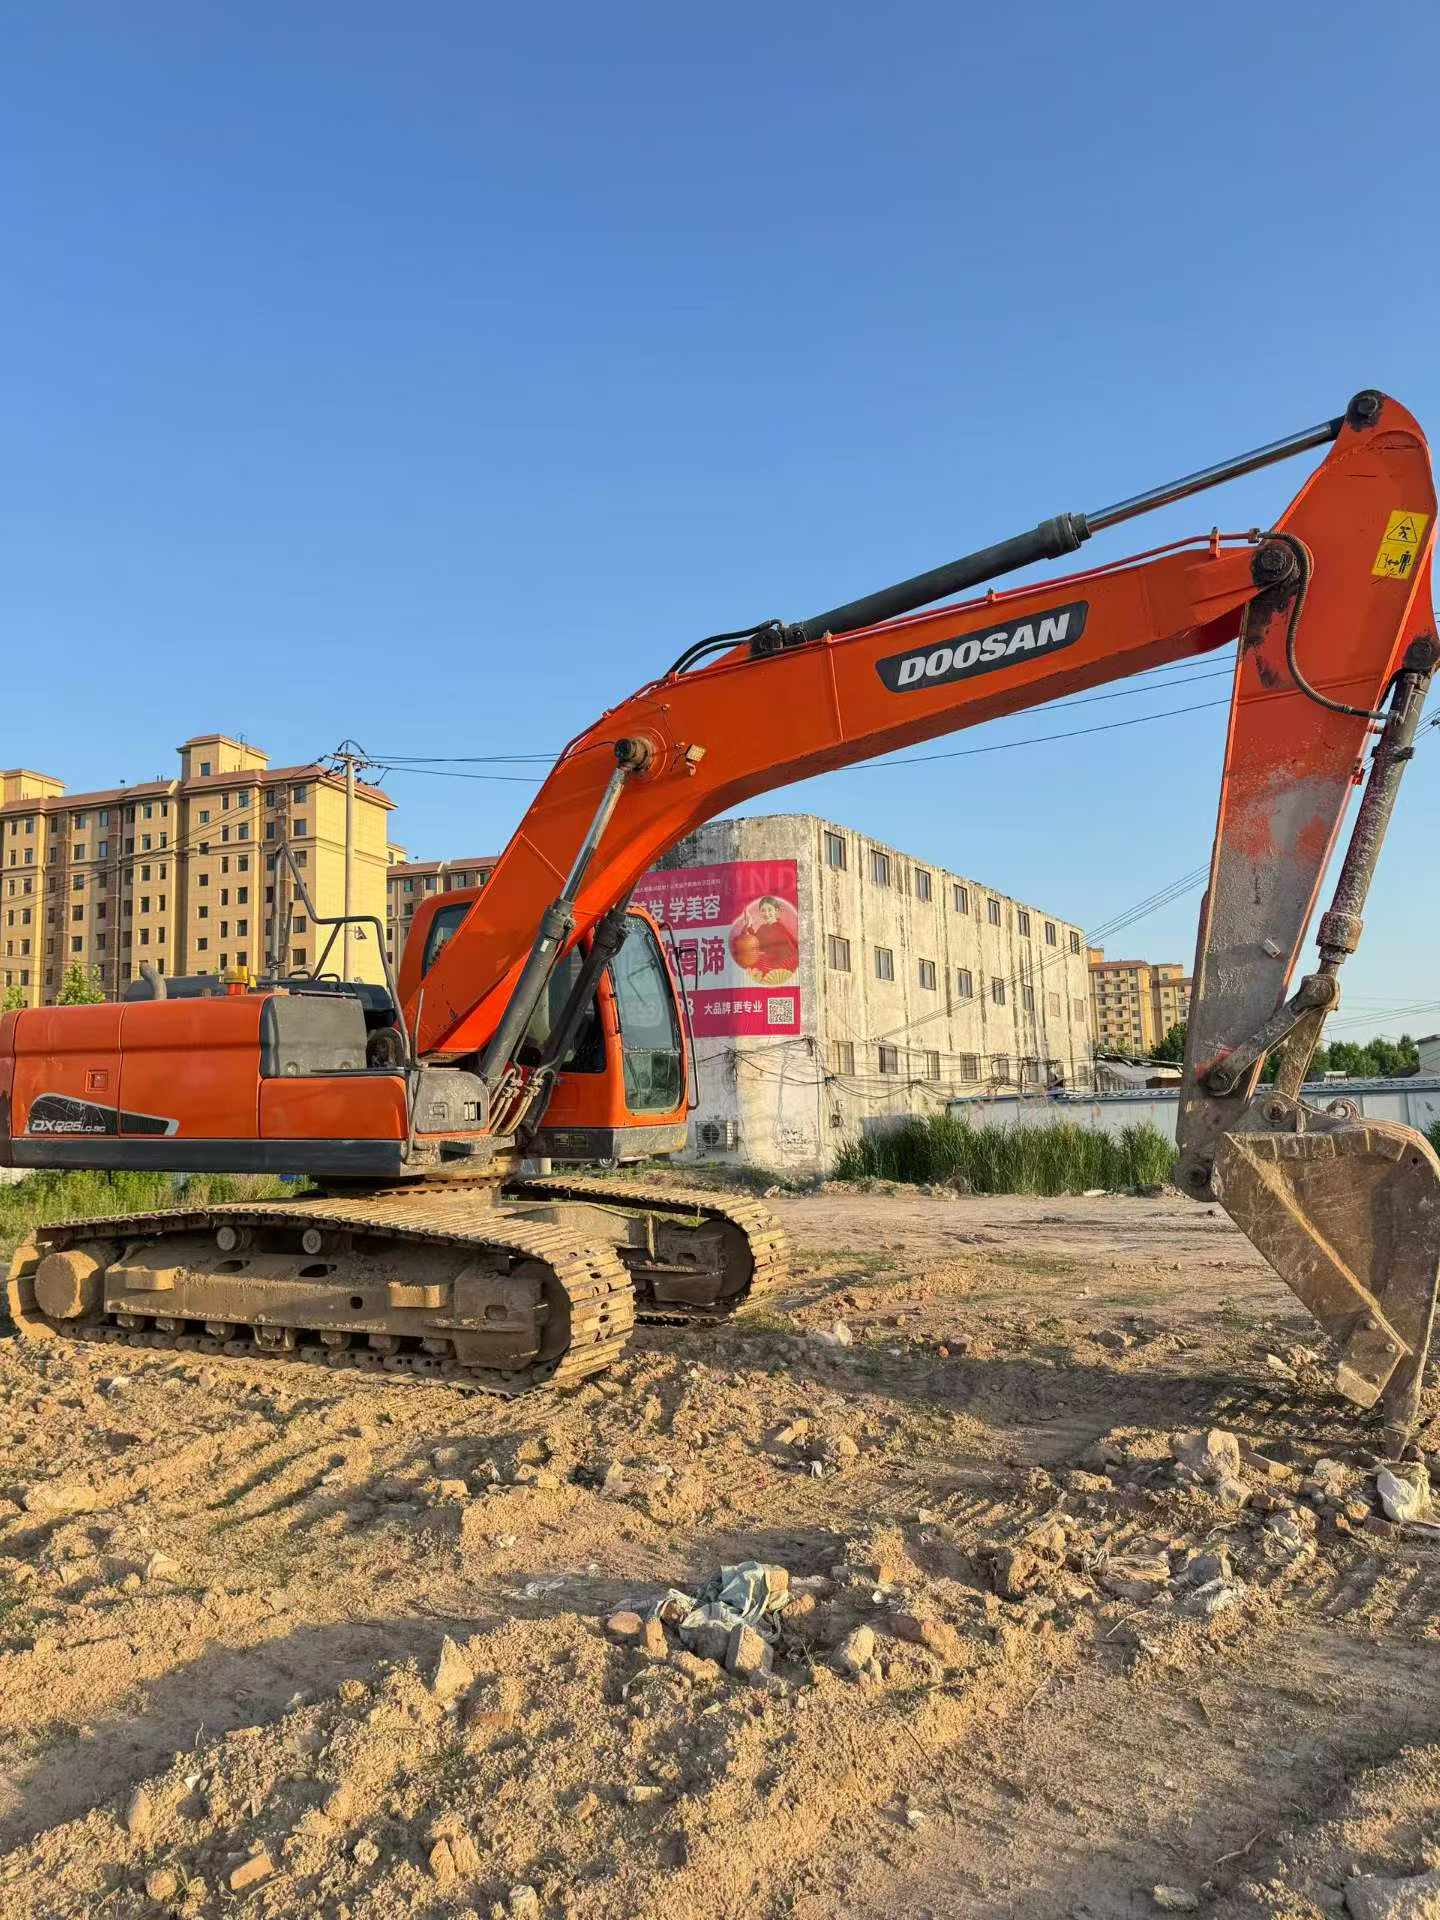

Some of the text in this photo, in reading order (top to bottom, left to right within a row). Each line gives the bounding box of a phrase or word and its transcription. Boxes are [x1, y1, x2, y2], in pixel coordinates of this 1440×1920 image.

[898, 613, 1070, 686] DOOSAN
[669, 895, 720, 922] 学美容
